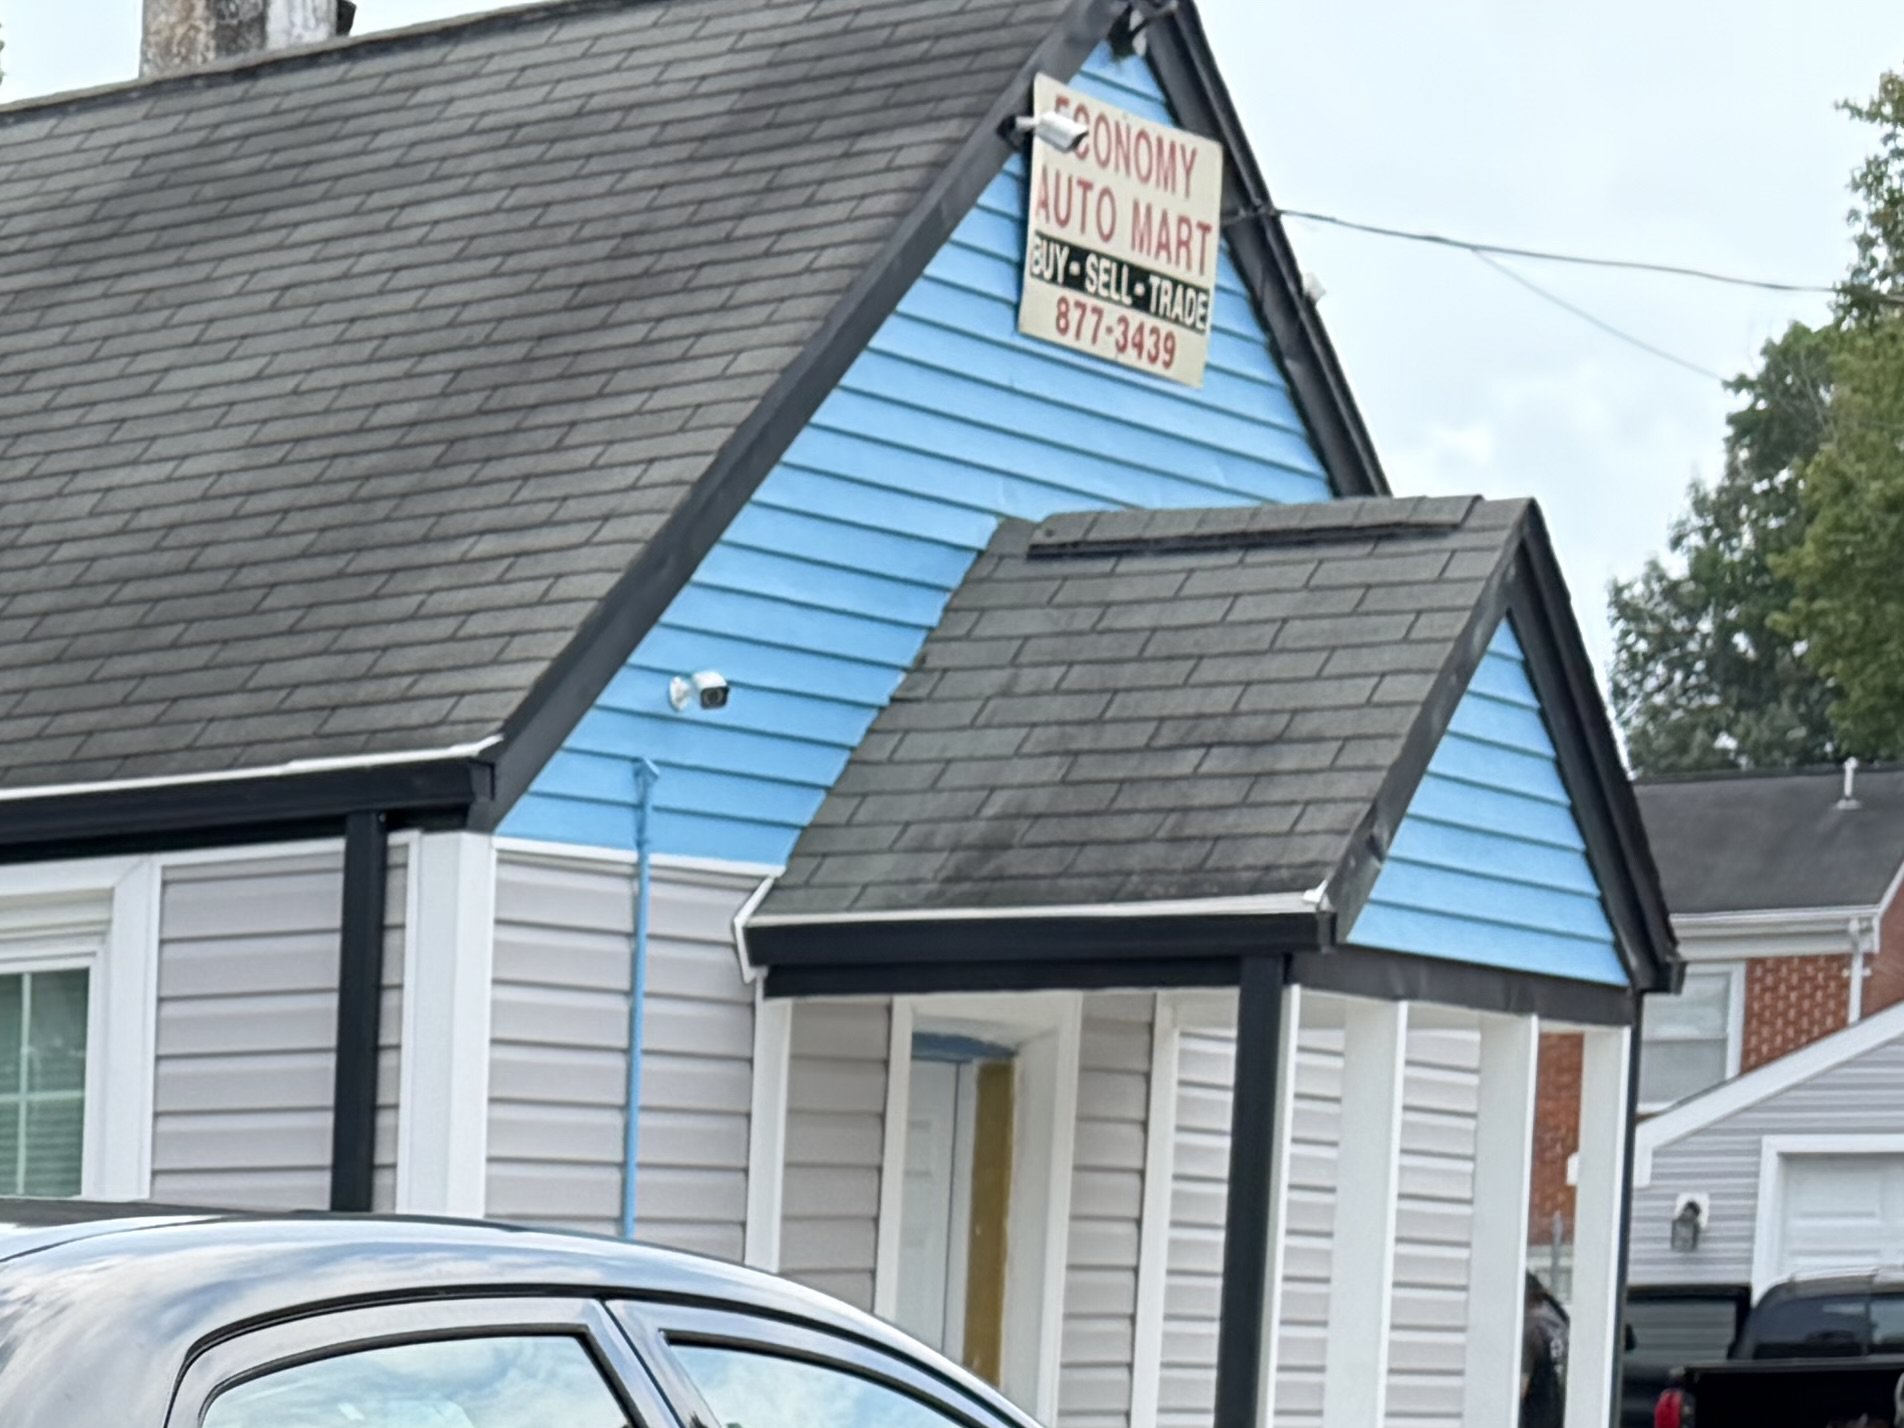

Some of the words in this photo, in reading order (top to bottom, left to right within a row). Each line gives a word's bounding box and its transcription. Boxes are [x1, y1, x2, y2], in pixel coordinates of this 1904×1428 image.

[1055, 96, 1198, 198] CONOMY
[1035, 165, 1117, 243] AUTO
[1131, 200, 1212, 276] MART
[1031, 234, 1071, 284] BUY
[1085, 252, 1132, 306] SELL
[1148, 275, 1207, 332] TRADE
[1055, 295, 1176, 370] 877-3439
